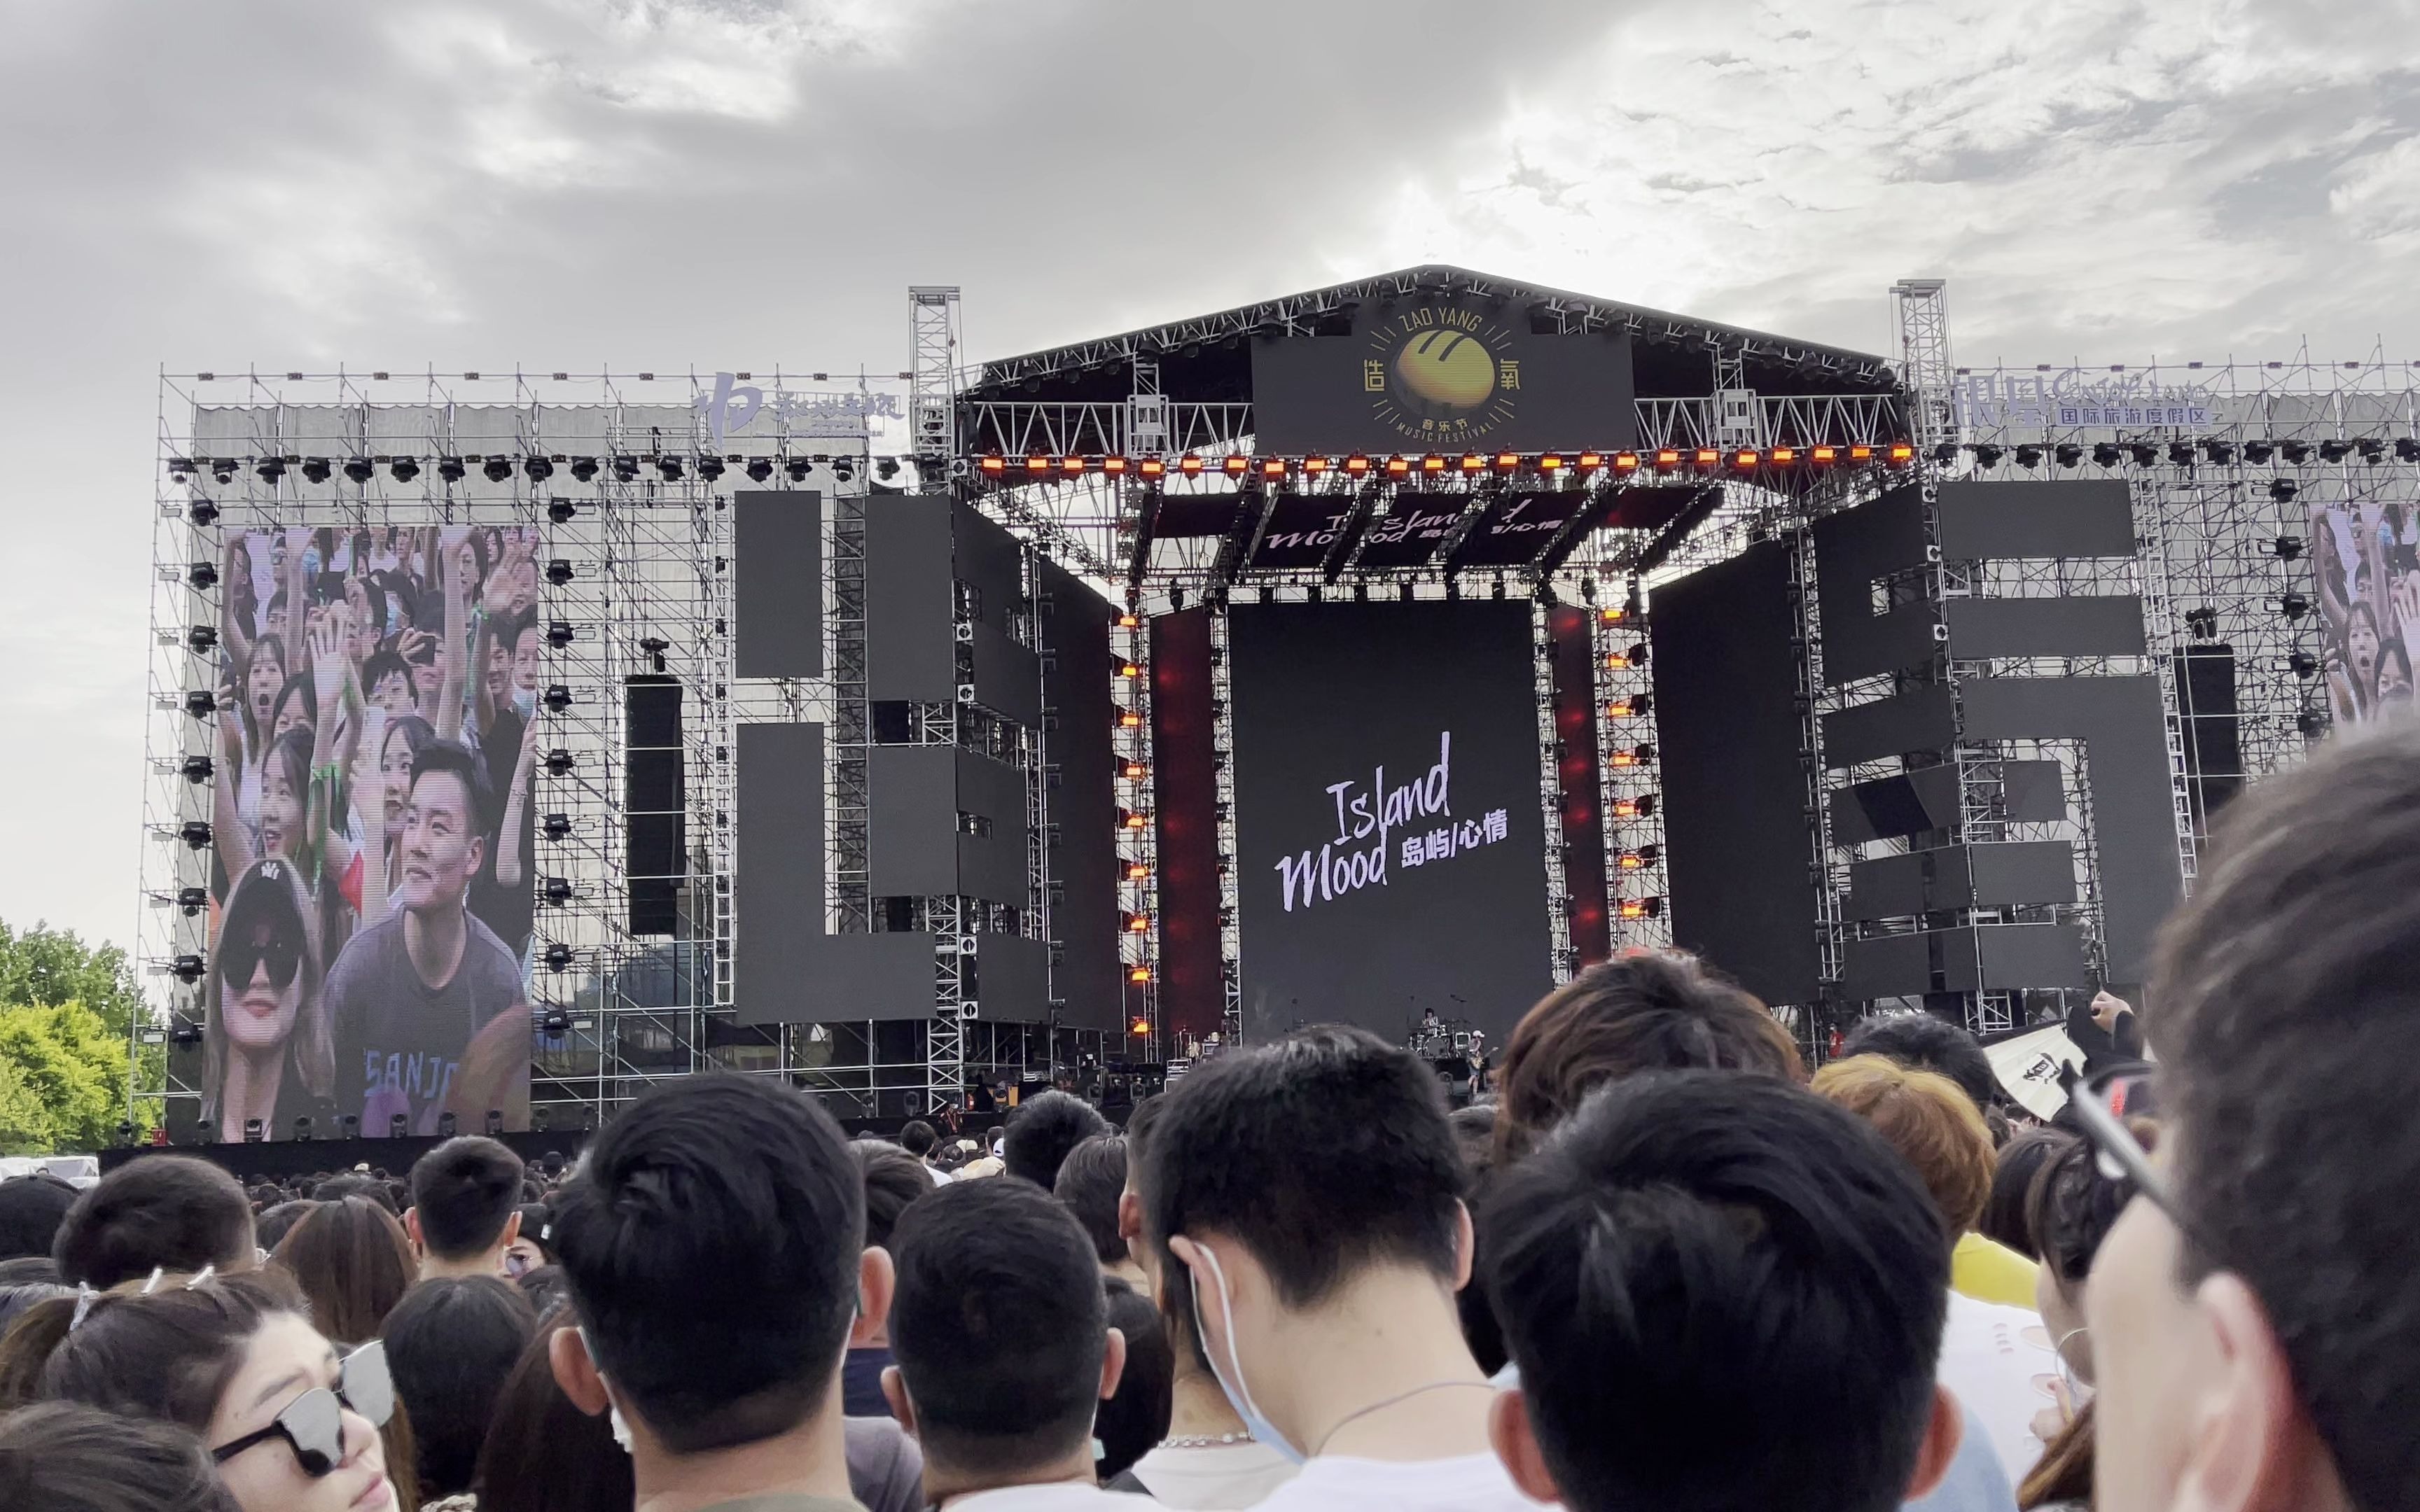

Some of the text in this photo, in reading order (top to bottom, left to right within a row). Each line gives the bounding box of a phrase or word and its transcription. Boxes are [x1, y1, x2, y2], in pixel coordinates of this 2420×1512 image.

[1398, 307, 1483, 332] ZAO YANG
[1421, 417, 1468, 433] 音乐节
[2061, 407, 2206, 424] 国际旅游度假区
[1395, 421, 1494, 443] MUSIC FESTIVAL
[1325, 731, 1452, 846] Island
[1400, 807, 1508, 869] 岛屿/心情
[1274, 843, 1389, 913] Mood
